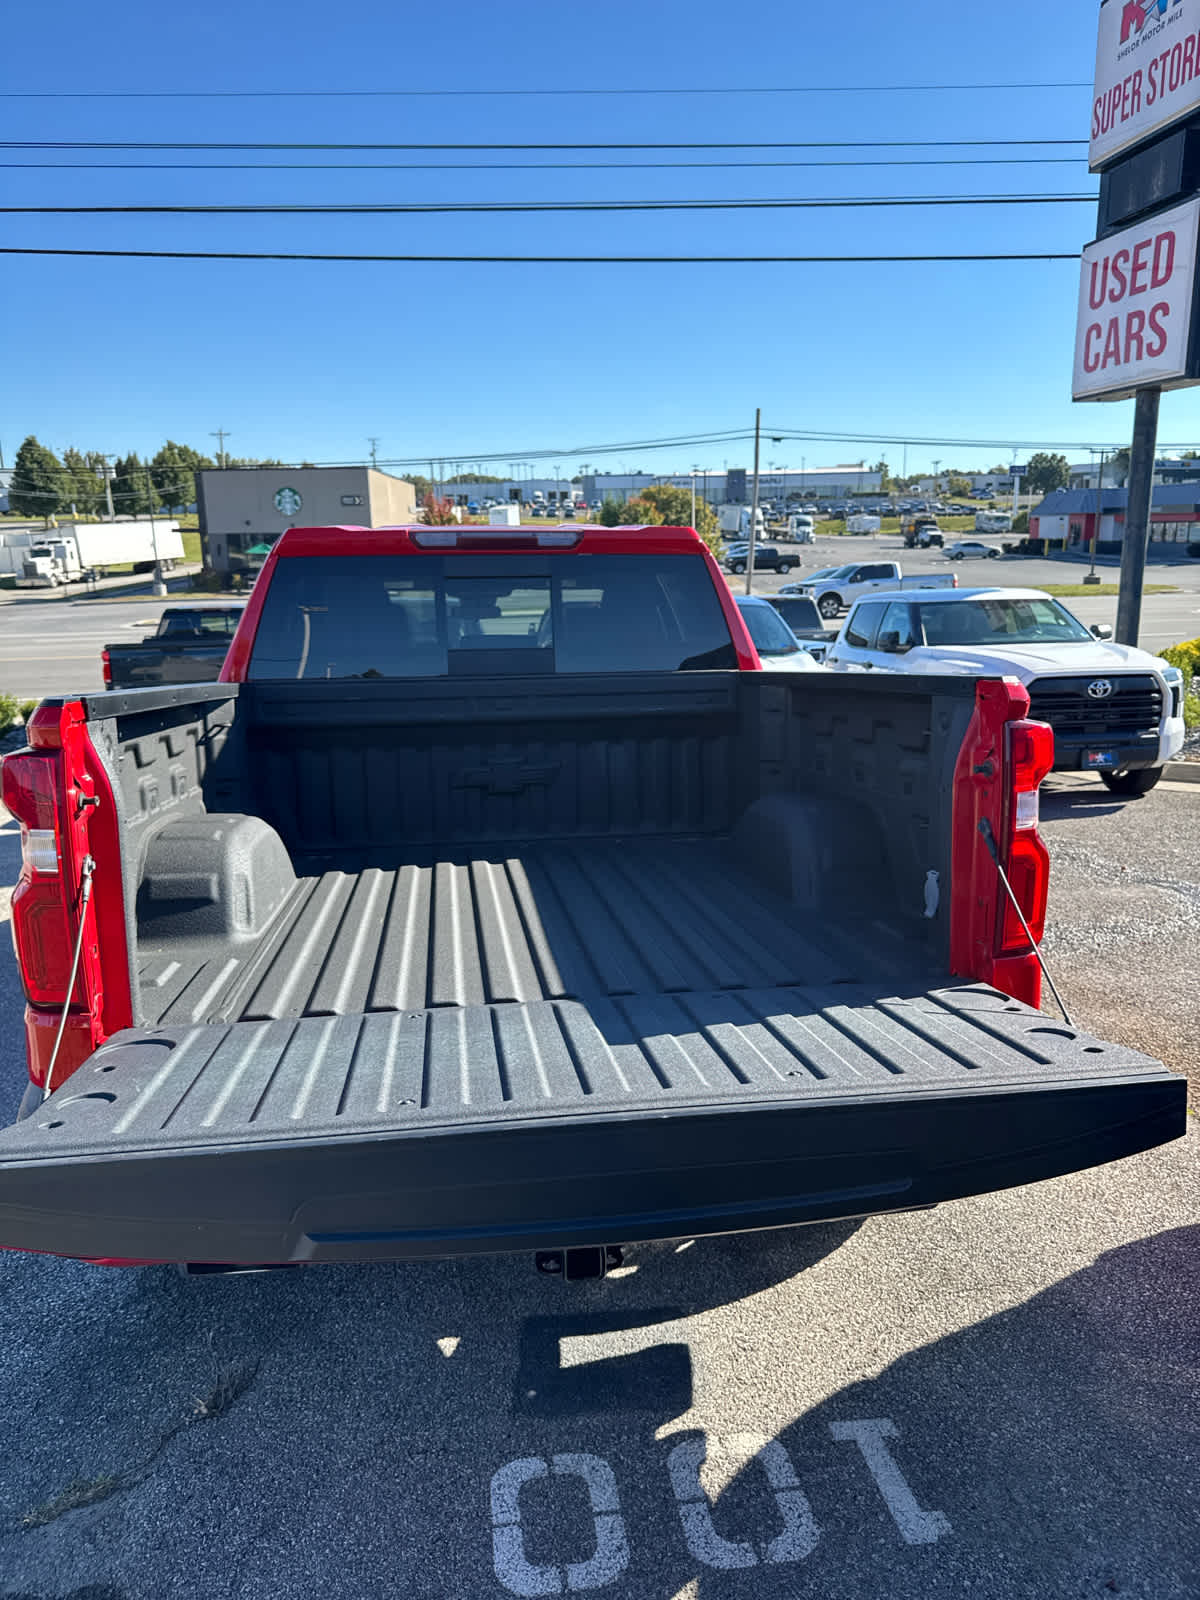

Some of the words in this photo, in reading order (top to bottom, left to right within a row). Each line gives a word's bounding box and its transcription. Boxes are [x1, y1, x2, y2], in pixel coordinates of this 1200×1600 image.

[1092, 69, 1143, 140] SUPER
[1089, 231, 1176, 310] USED
[1083, 302, 1170, 373] CARS
